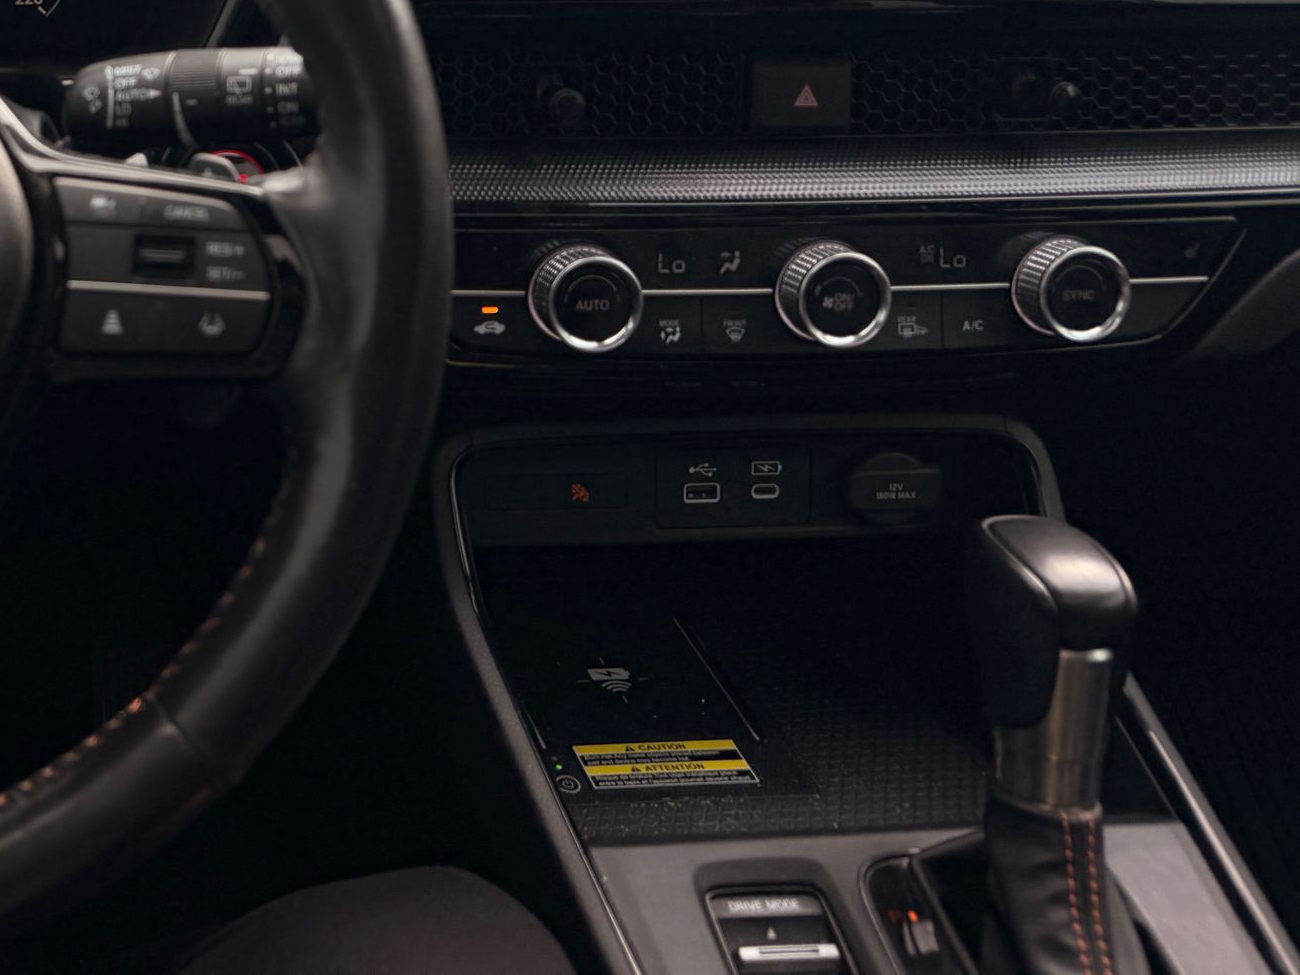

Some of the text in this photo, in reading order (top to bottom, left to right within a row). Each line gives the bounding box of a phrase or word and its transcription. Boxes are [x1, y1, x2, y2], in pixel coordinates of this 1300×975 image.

[657, 252, 687, 274] Lo
[939, 247, 968, 269] Lo
[1063, 289, 1095, 301] SYNC
[575, 299, 611, 312] AUTO
[962, 319, 984, 331] A/C
[637, 742, 687, 752] CAUTION
[644, 762, 706, 772] ATTENTION
[727, 897, 800, 913] DRIVE MODE
